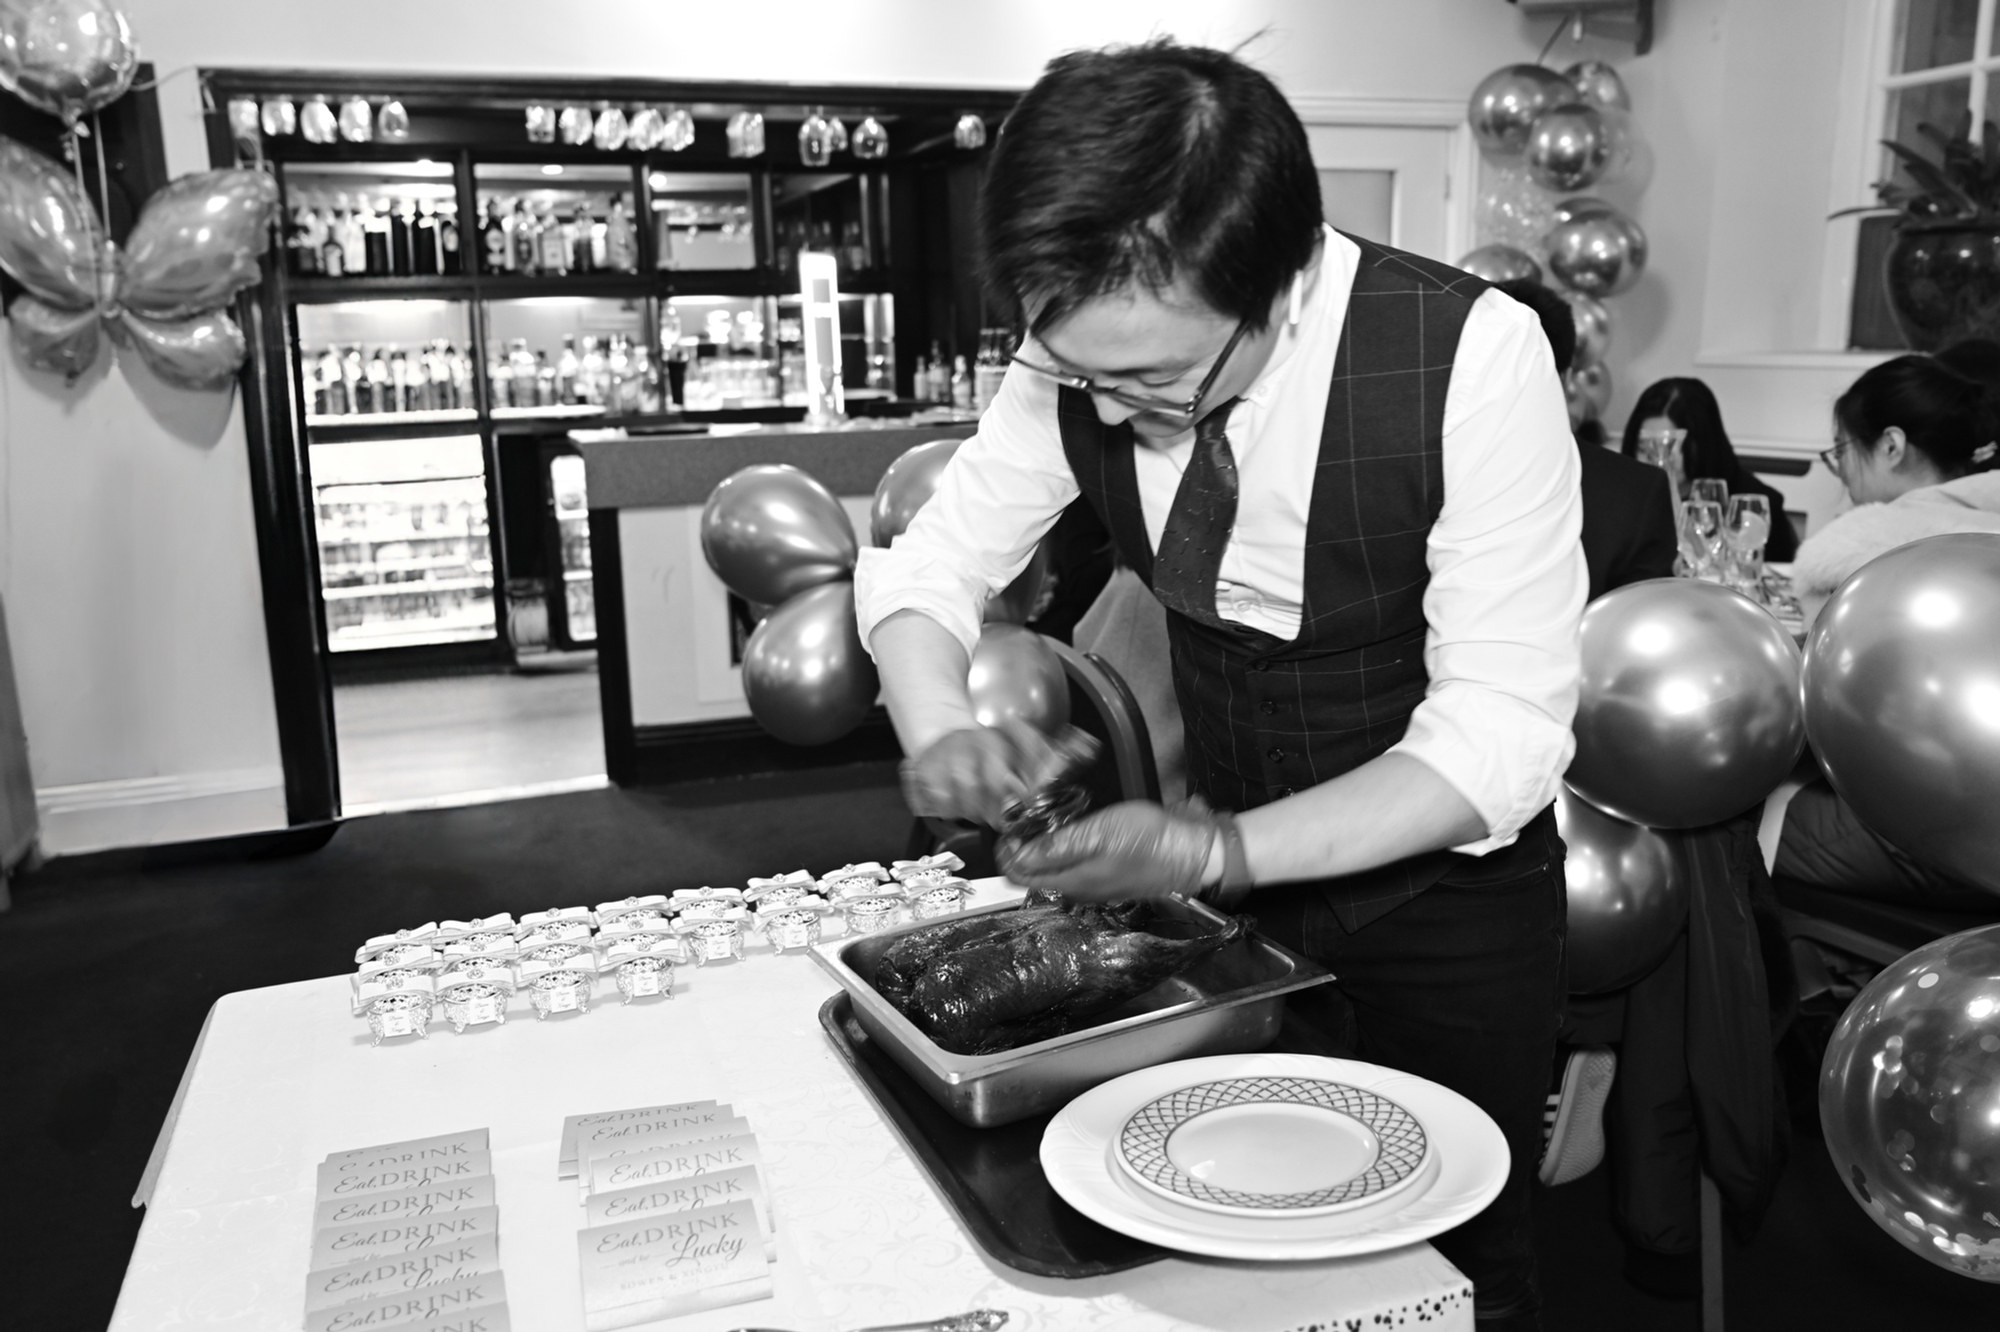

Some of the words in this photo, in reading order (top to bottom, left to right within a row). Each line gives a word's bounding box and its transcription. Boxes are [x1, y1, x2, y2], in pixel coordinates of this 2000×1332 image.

[619, 1104, 698, 1120] DRINK
[636, 1113, 716, 1134] DRINK
[380, 1160, 472, 1187] DRINK
[654, 1147, 743, 1176] DRINK
[381, 1186, 475, 1214] DRINK
[651, 1178, 743, 1208] DRINK
[381, 1217, 478, 1243] DRINK
[645, 1212, 739, 1244] DRINK
[376, 1246, 477, 1281] DRINK
[665, 1233, 747, 1268] Lucky
[381, 1285, 486, 1321] DRINK
